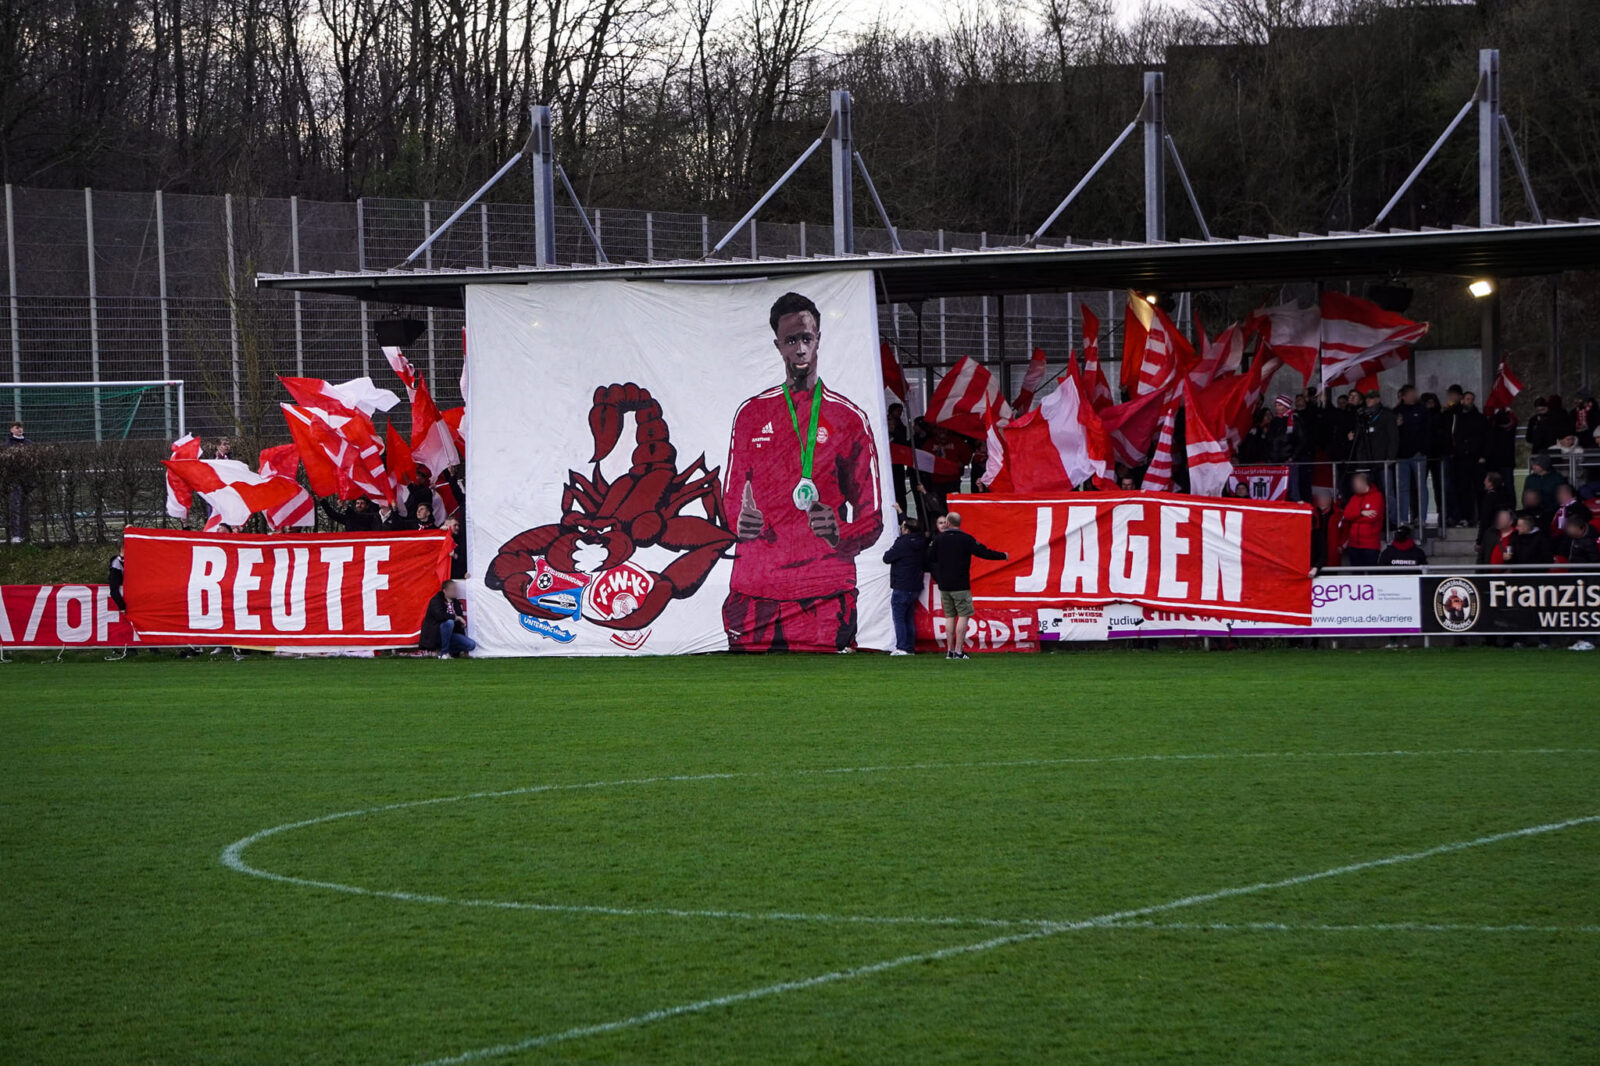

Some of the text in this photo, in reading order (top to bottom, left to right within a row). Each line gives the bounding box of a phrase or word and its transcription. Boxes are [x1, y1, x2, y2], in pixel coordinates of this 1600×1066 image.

[1014, 504, 1243, 602] JAGEN
[188, 546, 391, 631] BEUTE
[1311, 583, 1375, 608] genua
[1312, 614, 1413, 625] www.genua.de/karriere
